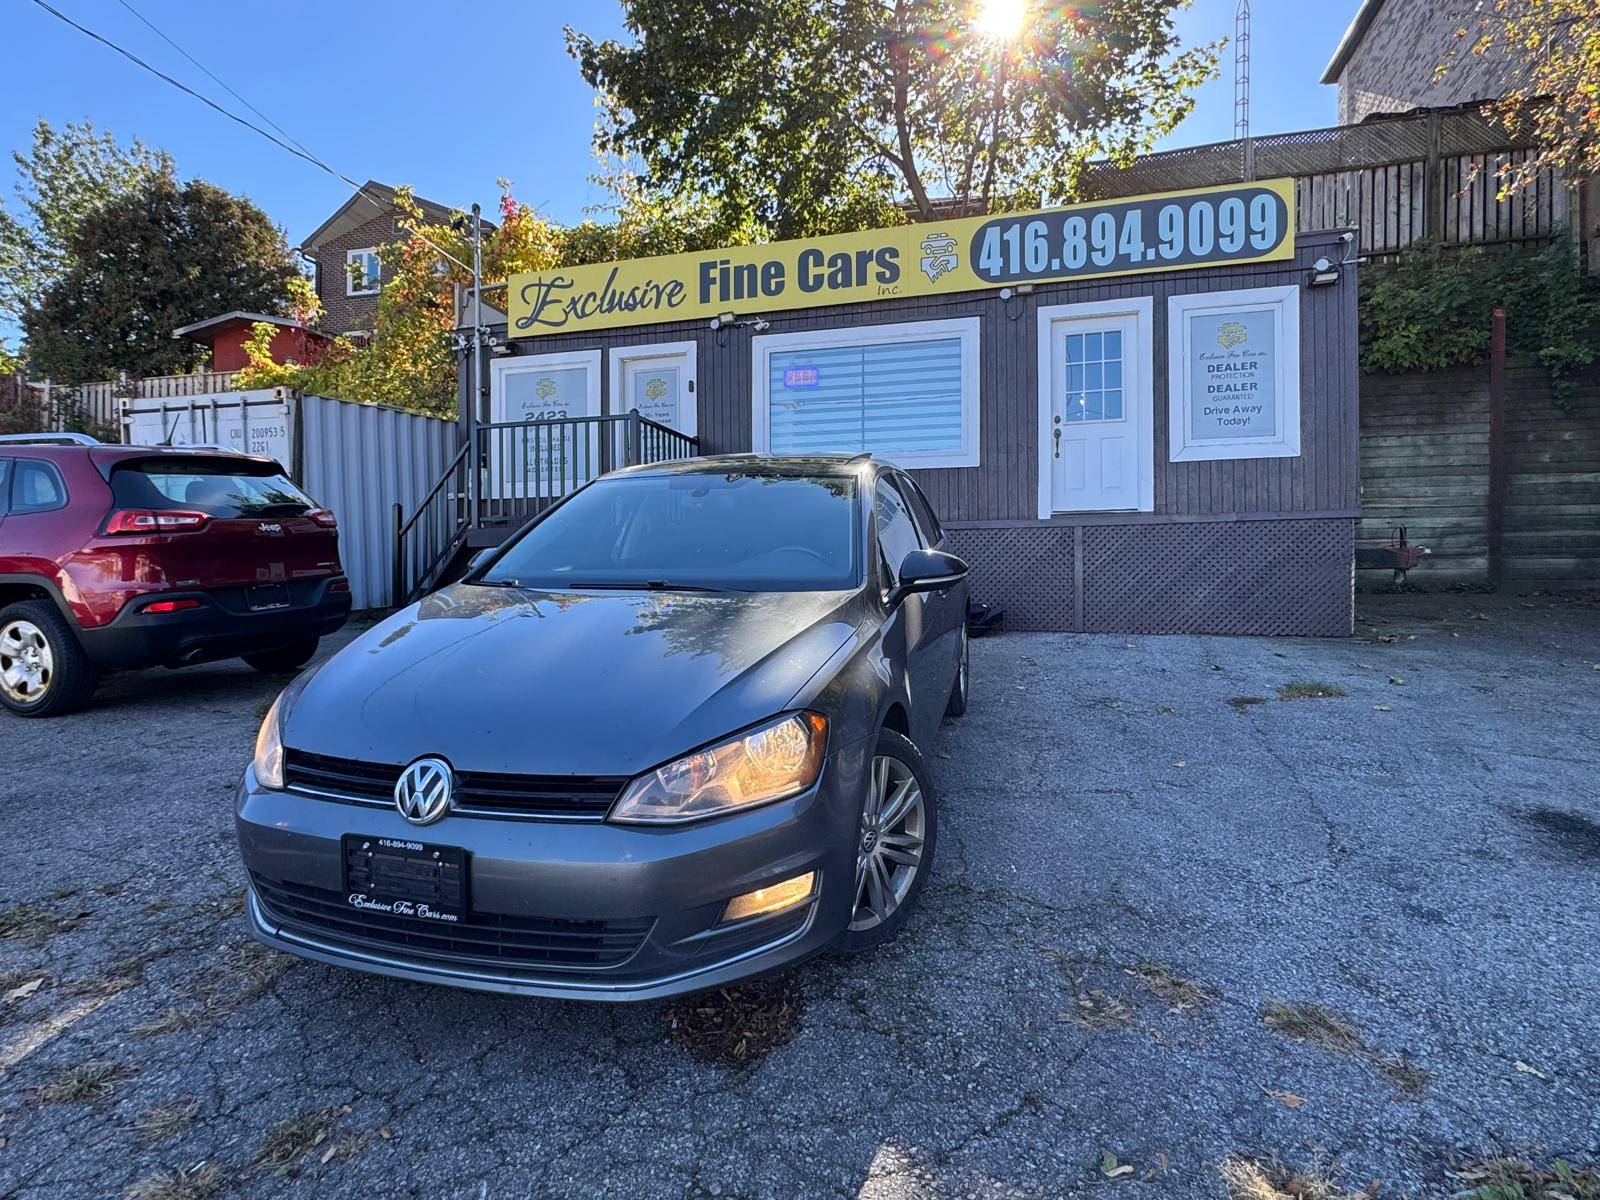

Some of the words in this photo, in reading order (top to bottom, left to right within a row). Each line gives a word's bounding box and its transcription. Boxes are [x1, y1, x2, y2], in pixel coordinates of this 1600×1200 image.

[979, 193, 1277, 276] 416.894.9099
[515, 266, 687, 330] Exclusive
[699, 259, 786, 304] Fine
[797, 246, 901, 293] Cars
[876, 284, 903, 296] Inc.
[1207, 361, 1258, 373] DEALER
[1210, 371, 1255, 380] PROTECTION
[1207, 382, 1258, 394] DEALER
[525, 410, 567, 421] 2423
[1204, 406, 1230, 415] Drive
[1233, 405, 1263, 414] Away
[1217, 416, 1251, 427] Today!
[258, 522, 281, 532] Jeep
[378, 839, 424, 851] 416-894-9099
[393, 901, 415, 915] Fine
